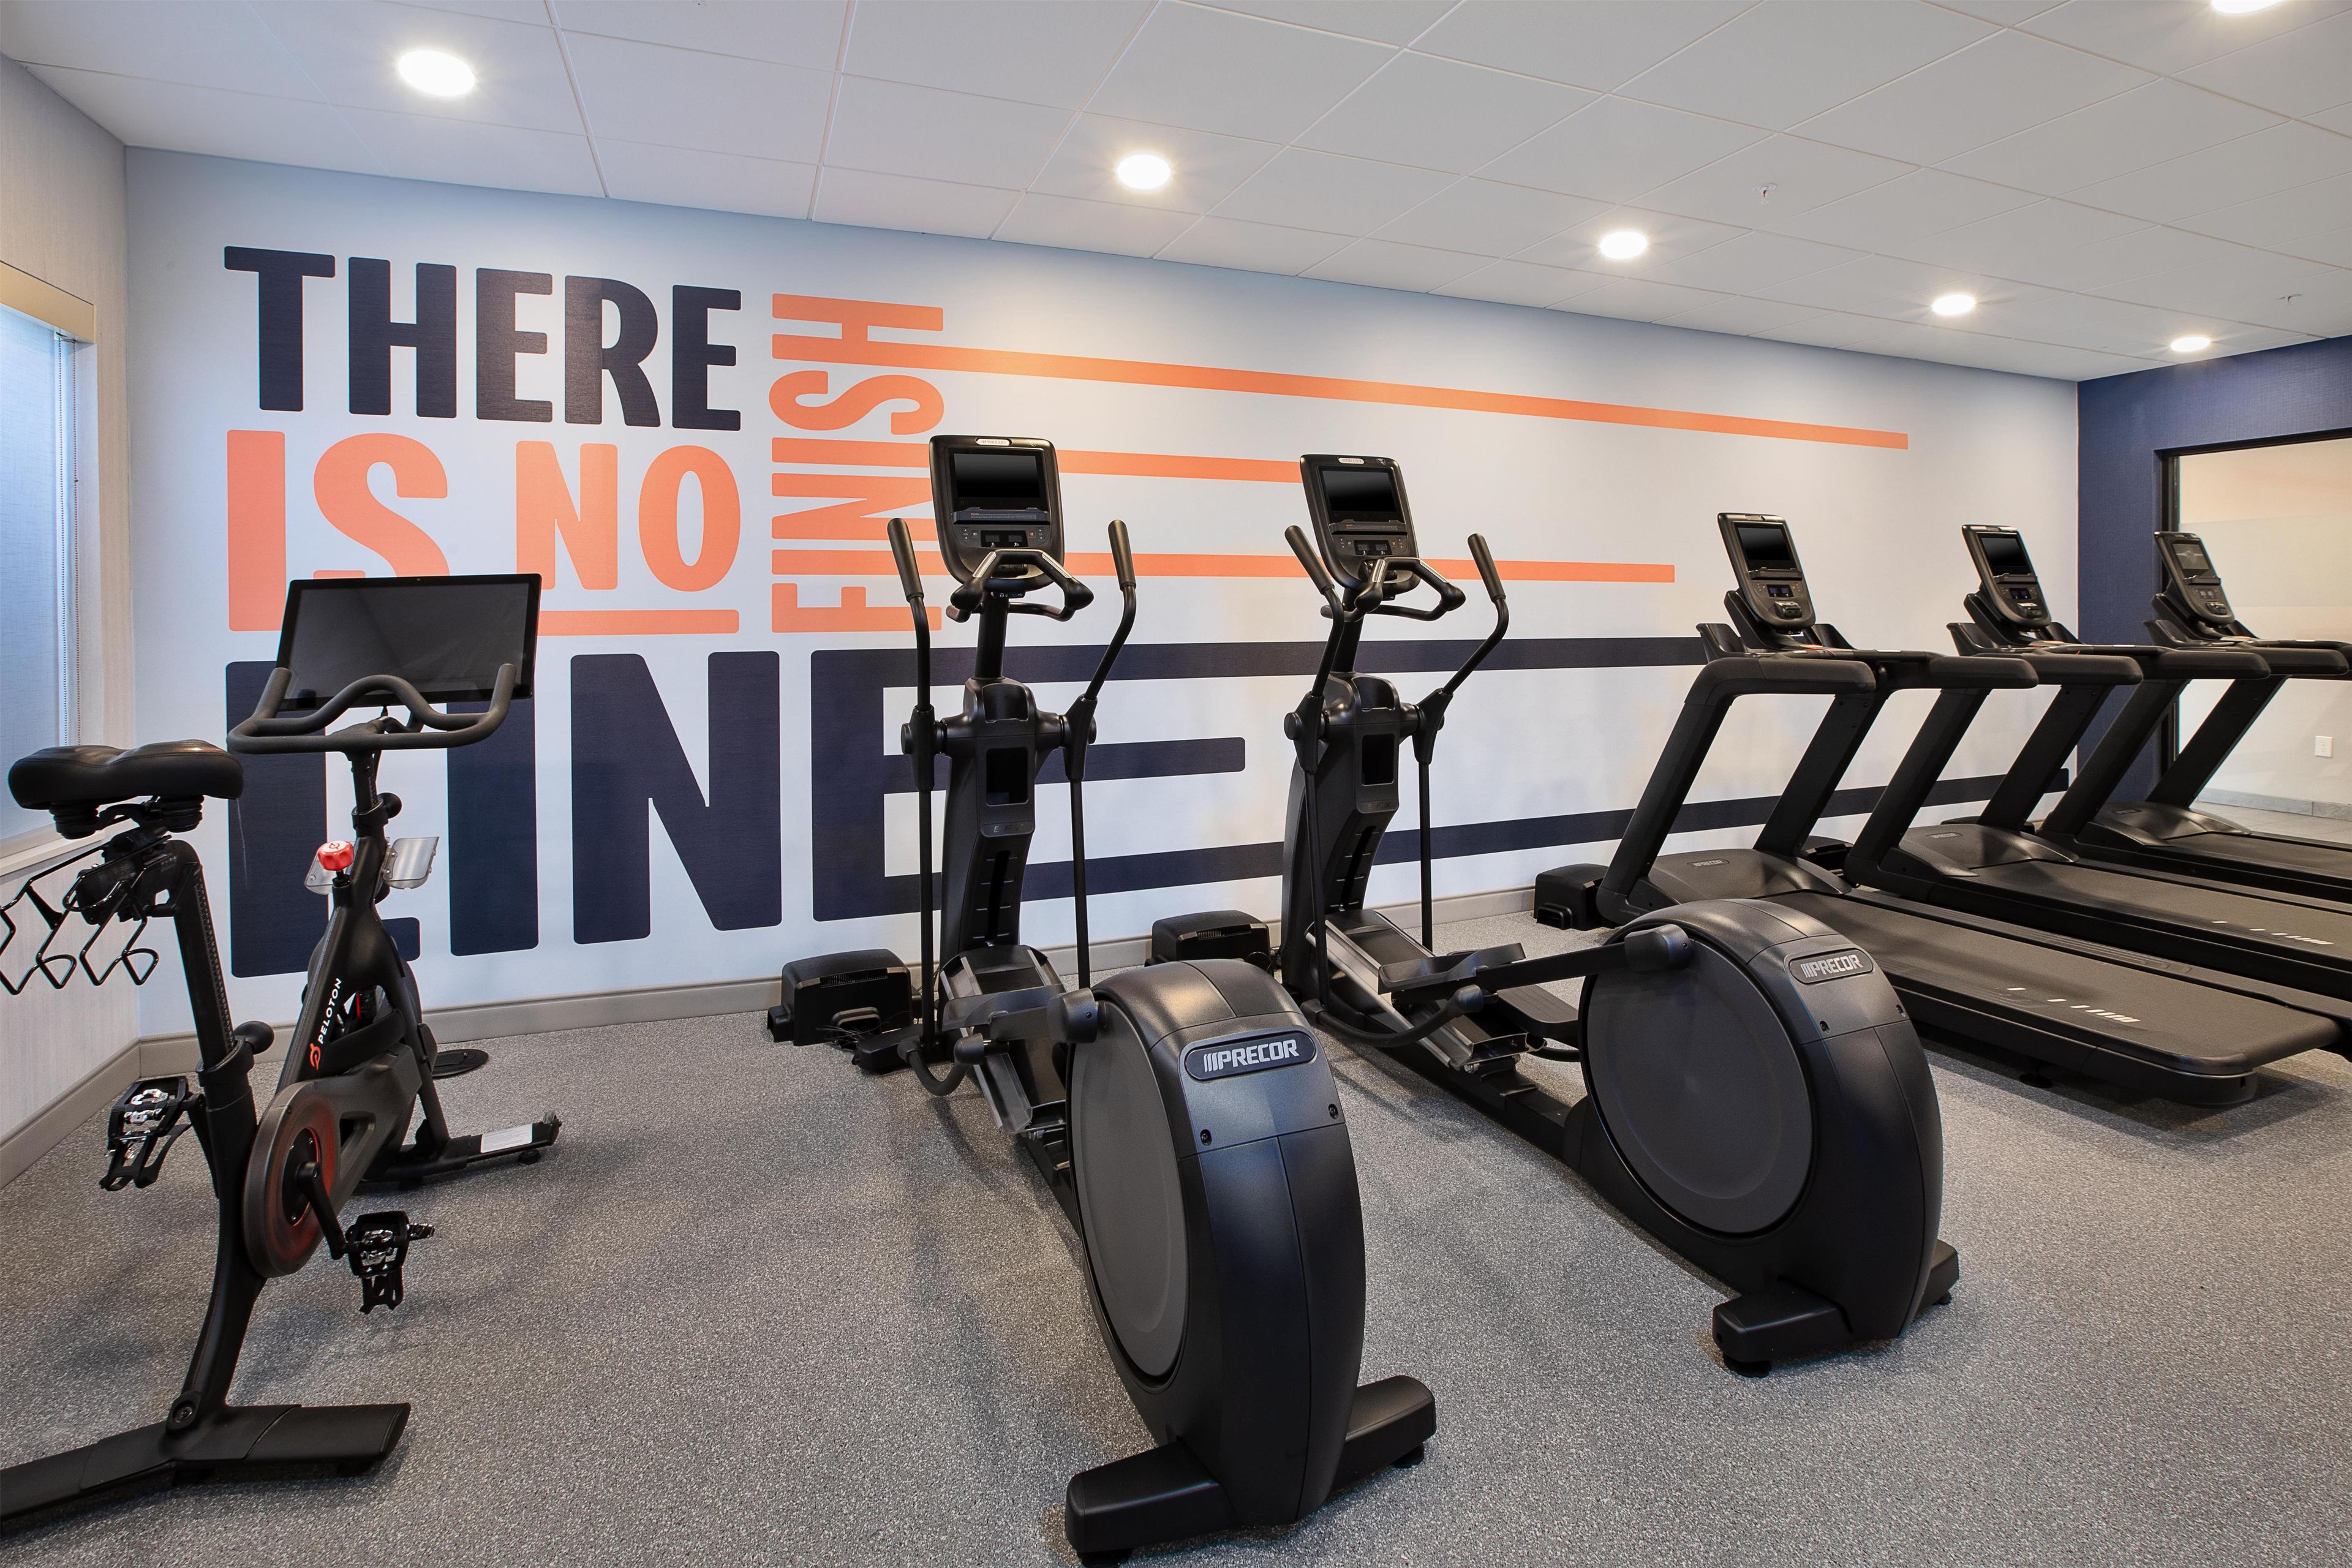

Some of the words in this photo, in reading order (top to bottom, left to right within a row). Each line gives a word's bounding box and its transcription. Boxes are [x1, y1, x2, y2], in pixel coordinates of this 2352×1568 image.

[224, 246, 741, 431] THERE
[227, 430, 450, 631] IS
[516, 440, 741, 592] NO
[769, 293, 944, 633] FINISH
[226, 649, 1246, 978] LINE
[317, 977, 343, 1045] PELOTON
[1215, 1038, 1300, 1072] PRECOR
[1807, 954, 1863, 978] PRECOR
